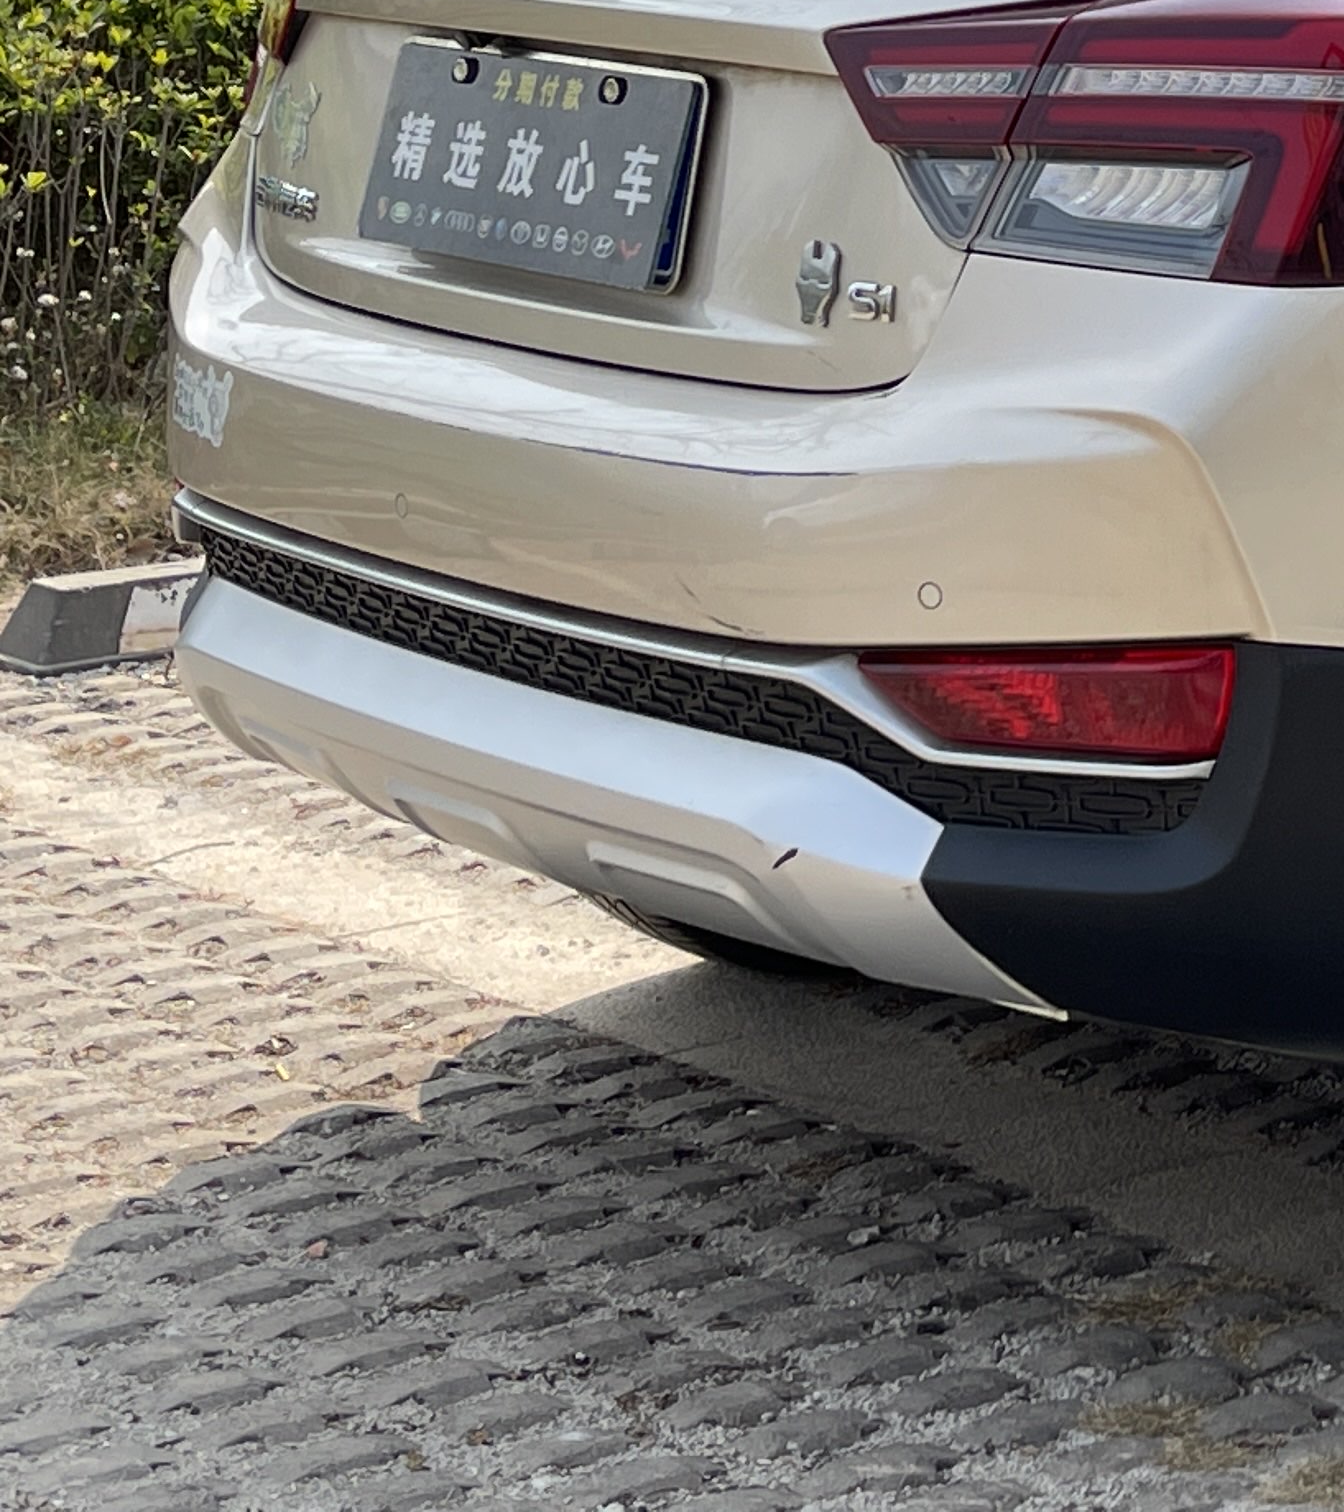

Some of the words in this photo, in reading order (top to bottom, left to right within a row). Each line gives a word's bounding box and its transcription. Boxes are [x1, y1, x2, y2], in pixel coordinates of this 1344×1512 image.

[492, 68, 585, 111] 分期付款
[391, 110, 660, 217] 精选放心车
[847, 281, 897, 323] S1
